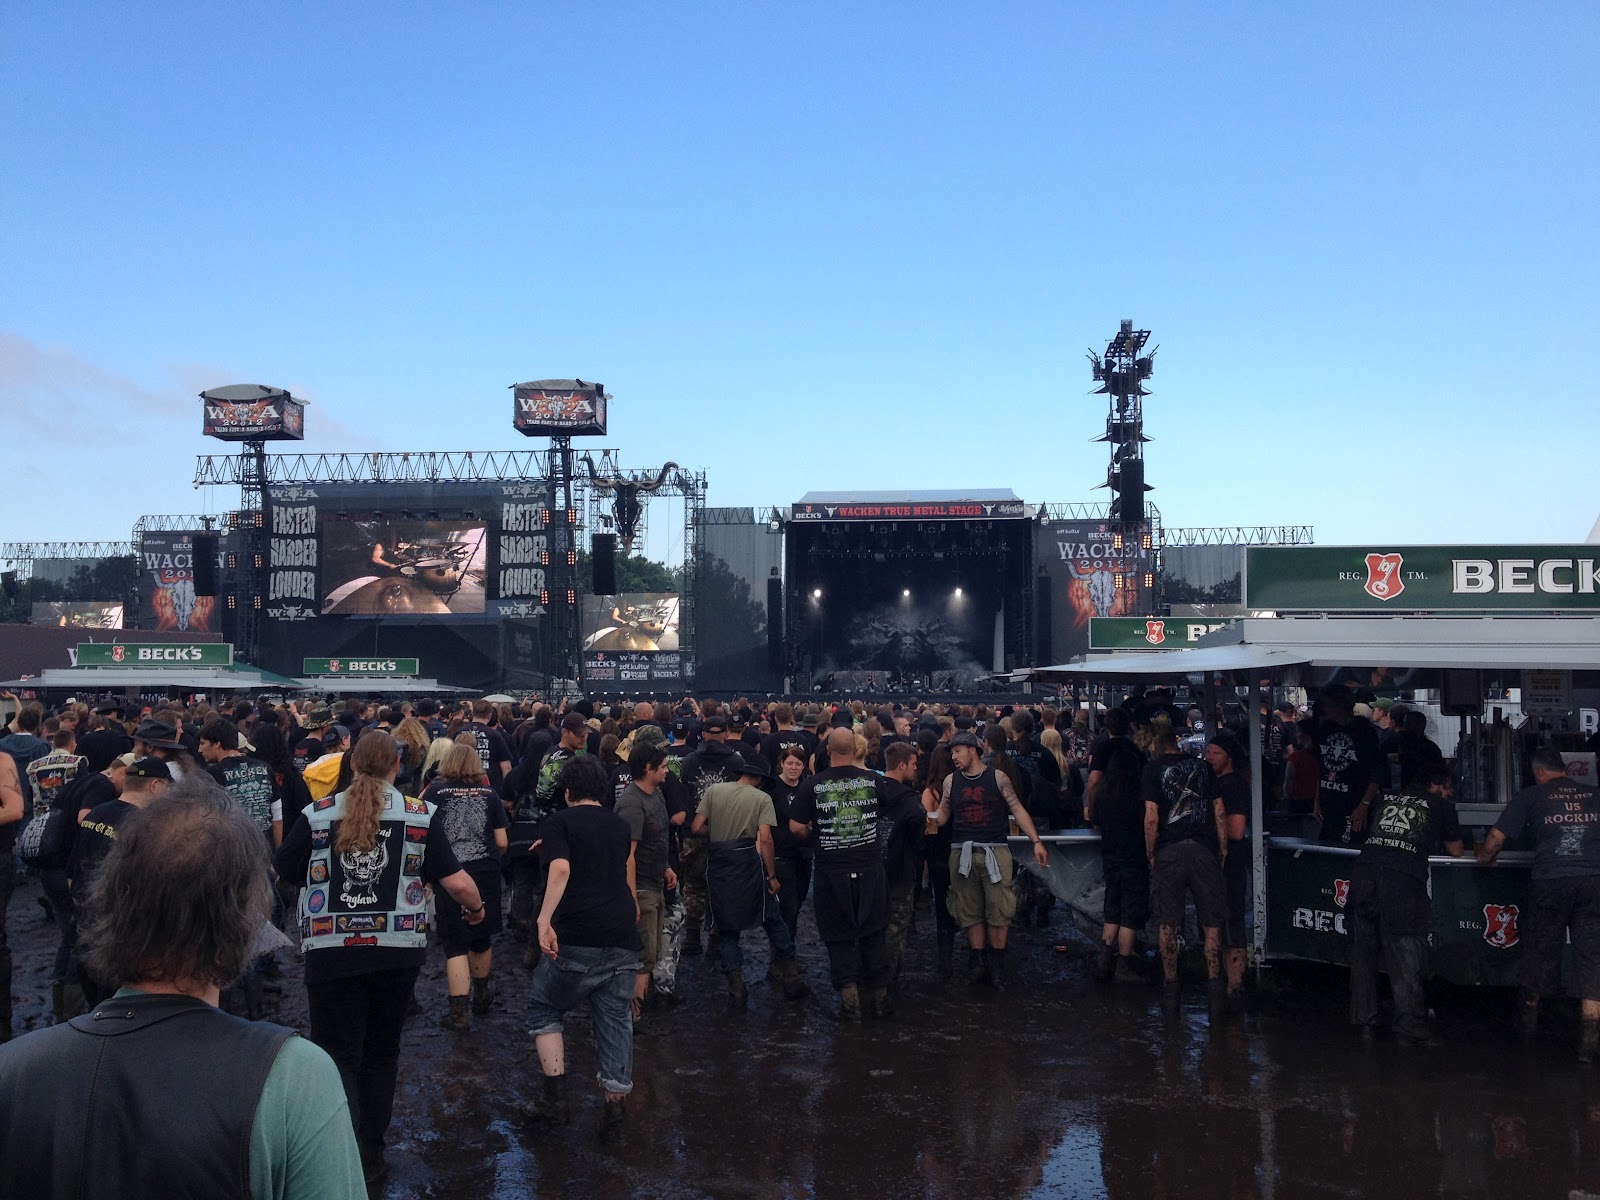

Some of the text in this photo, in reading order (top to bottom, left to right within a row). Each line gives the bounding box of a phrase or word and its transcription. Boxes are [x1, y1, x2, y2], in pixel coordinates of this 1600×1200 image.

[535, 412, 577, 420] 2012
[223, 418, 263, 427] 2012
[838, 505, 982, 516] WACKEN TRUE METAL STAGE
[272, 505, 317, 535] FASTER
[502, 501, 546, 532] FASTER
[269, 538, 317, 568] HARDER
[499, 535, 547, 566] HARDER
[1057, 541, 1147, 560] WACKEN
[143, 552, 226, 570] WACN
[1080, 559, 1126, 570] 2012
[165, 569, 194, 579] 201
[1339, 572, 1363, 580] REG.
[1407, 572, 1428, 580] TM.
[269, 570, 316, 602] LOUDER
[499, 568, 546, 599] LOUDER
[138, 646, 202, 660] BECK'S
[348, 660, 397, 671] BECK'S
[585, 660, 617, 668] BECK'S
[1005, 749, 1043, 758] WACEN
[223, 766, 269, 781] WACKEN
[1319, 780, 1349, 793] ECK'S
[1564, 802, 1581, 811] US
[861, 811, 878, 821] RAGE
[1380, 825, 1405, 835] YEARS
[340, 892, 379, 909] England
[1459, 921, 1482, 930] REG.
